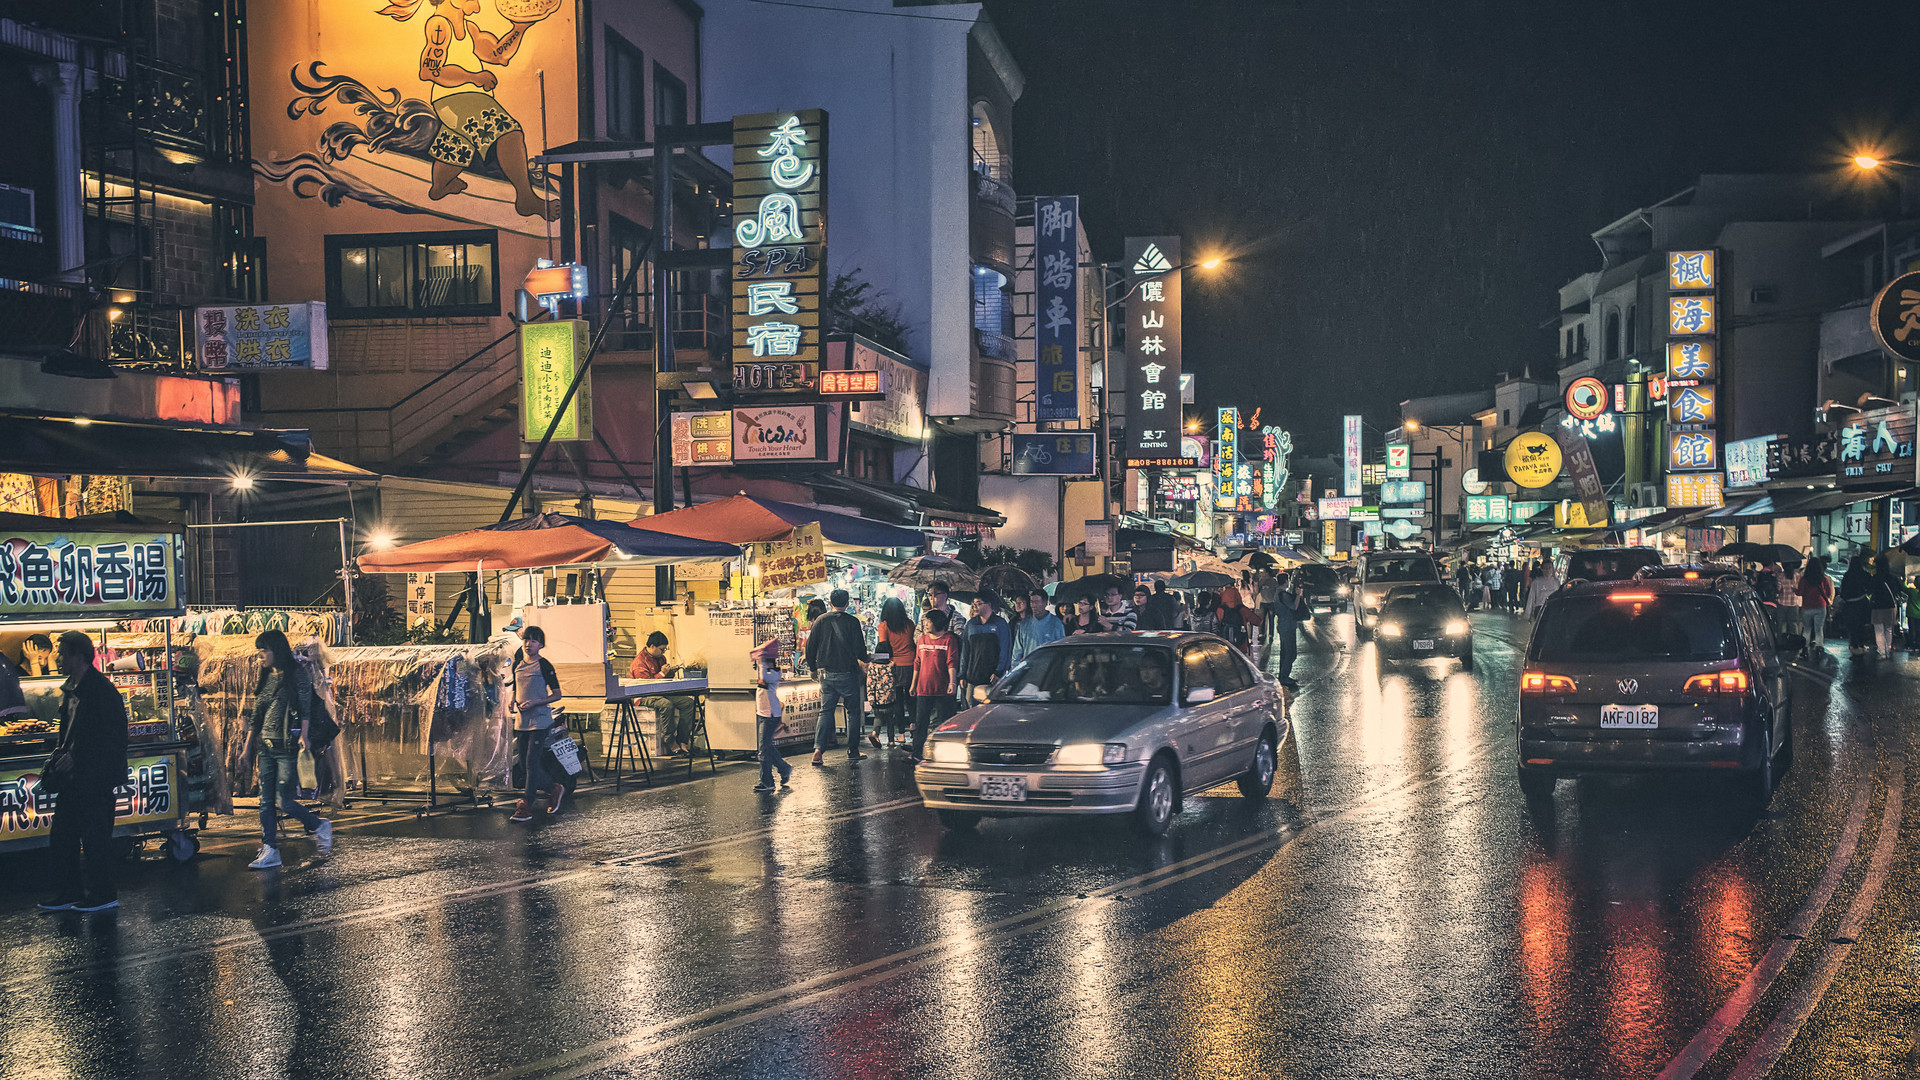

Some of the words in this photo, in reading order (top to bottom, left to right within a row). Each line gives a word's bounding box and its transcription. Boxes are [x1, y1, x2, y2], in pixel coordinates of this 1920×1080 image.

[737, 247, 810, 277] SPA
[235, 306, 291, 331] 洗衣
[747, 281, 802, 357] 民宿
[204, 309, 228, 368] 投幣
[235, 338, 292, 362] 烘衣
[1140, 281, 1167, 411] 儷山林會館
[733, 363, 815, 390] HOTEL
[696, 416, 728, 429] 洗衣
[696, 441, 728, 454] 烘衣
[1513, 463, 1538, 473] PAPAYA
[1469, 498, 1507, 520] 藥局
[409, 573, 433, 584] 禁止
[416, 586, 426, 599] 停
